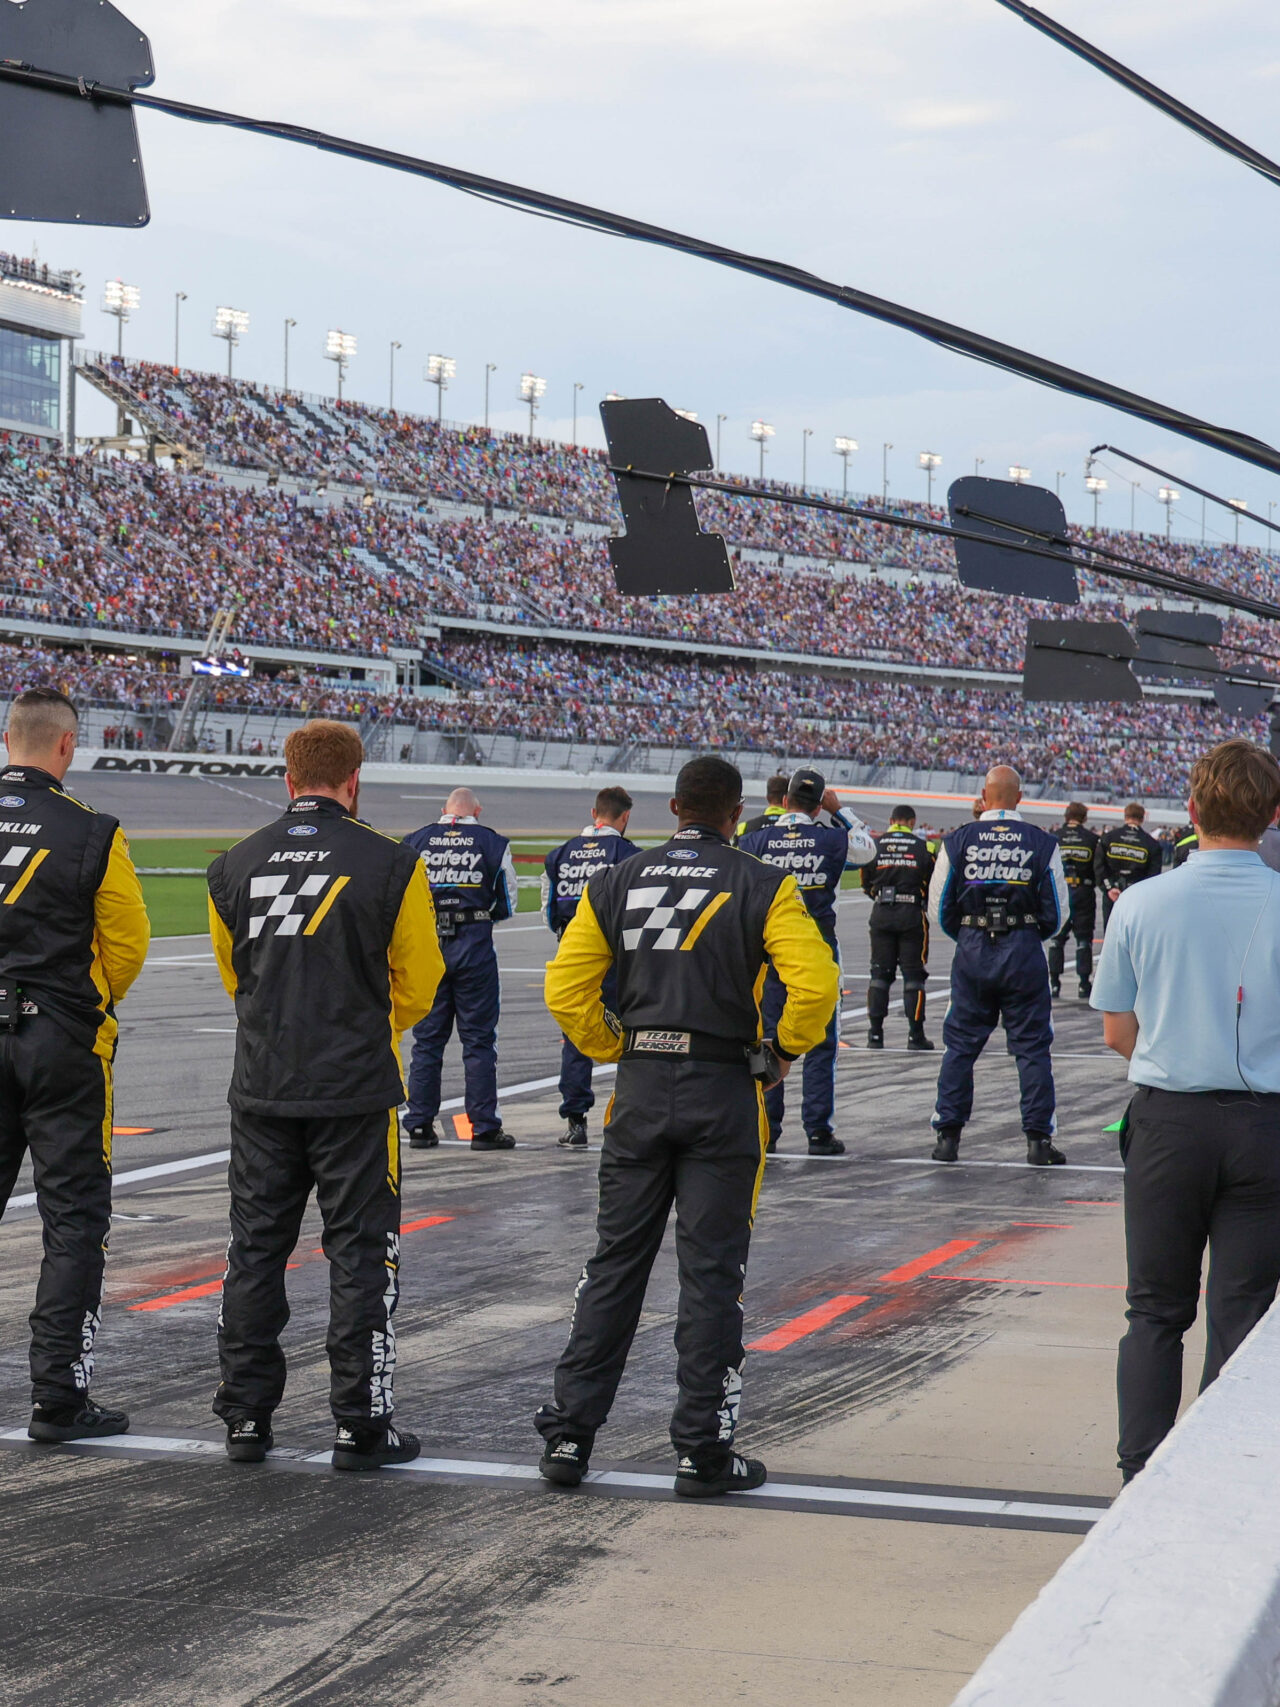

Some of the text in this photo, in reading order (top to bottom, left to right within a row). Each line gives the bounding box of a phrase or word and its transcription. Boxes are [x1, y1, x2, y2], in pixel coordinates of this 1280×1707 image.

[91, 756, 287, 777] DAYTONA
[428, 837, 474, 846] SIMMONS
[767, 838, 816, 849] ROBERTS
[978, 832, 1022, 842] WILSON
[267, 851, 331, 863] APSEY
[420, 849, 483, 870] Safety
[569, 848, 606, 859] POZEGA
[965, 844, 1034, 867] Safety
[639, 865, 719, 878] FRANCE
[964, 863, 1033, 881] Culture
[646, 1031, 683, 1041] TEAM
[635, 1041, 687, 1051] PENSKE
[81, 1309, 94, 1351] AUTO
[371, 1329, 385, 1374] AUTO
[387, 1429, 400, 1446] N
[559, 1452, 579, 1461] balance
[733, 1457, 748, 1477] N
